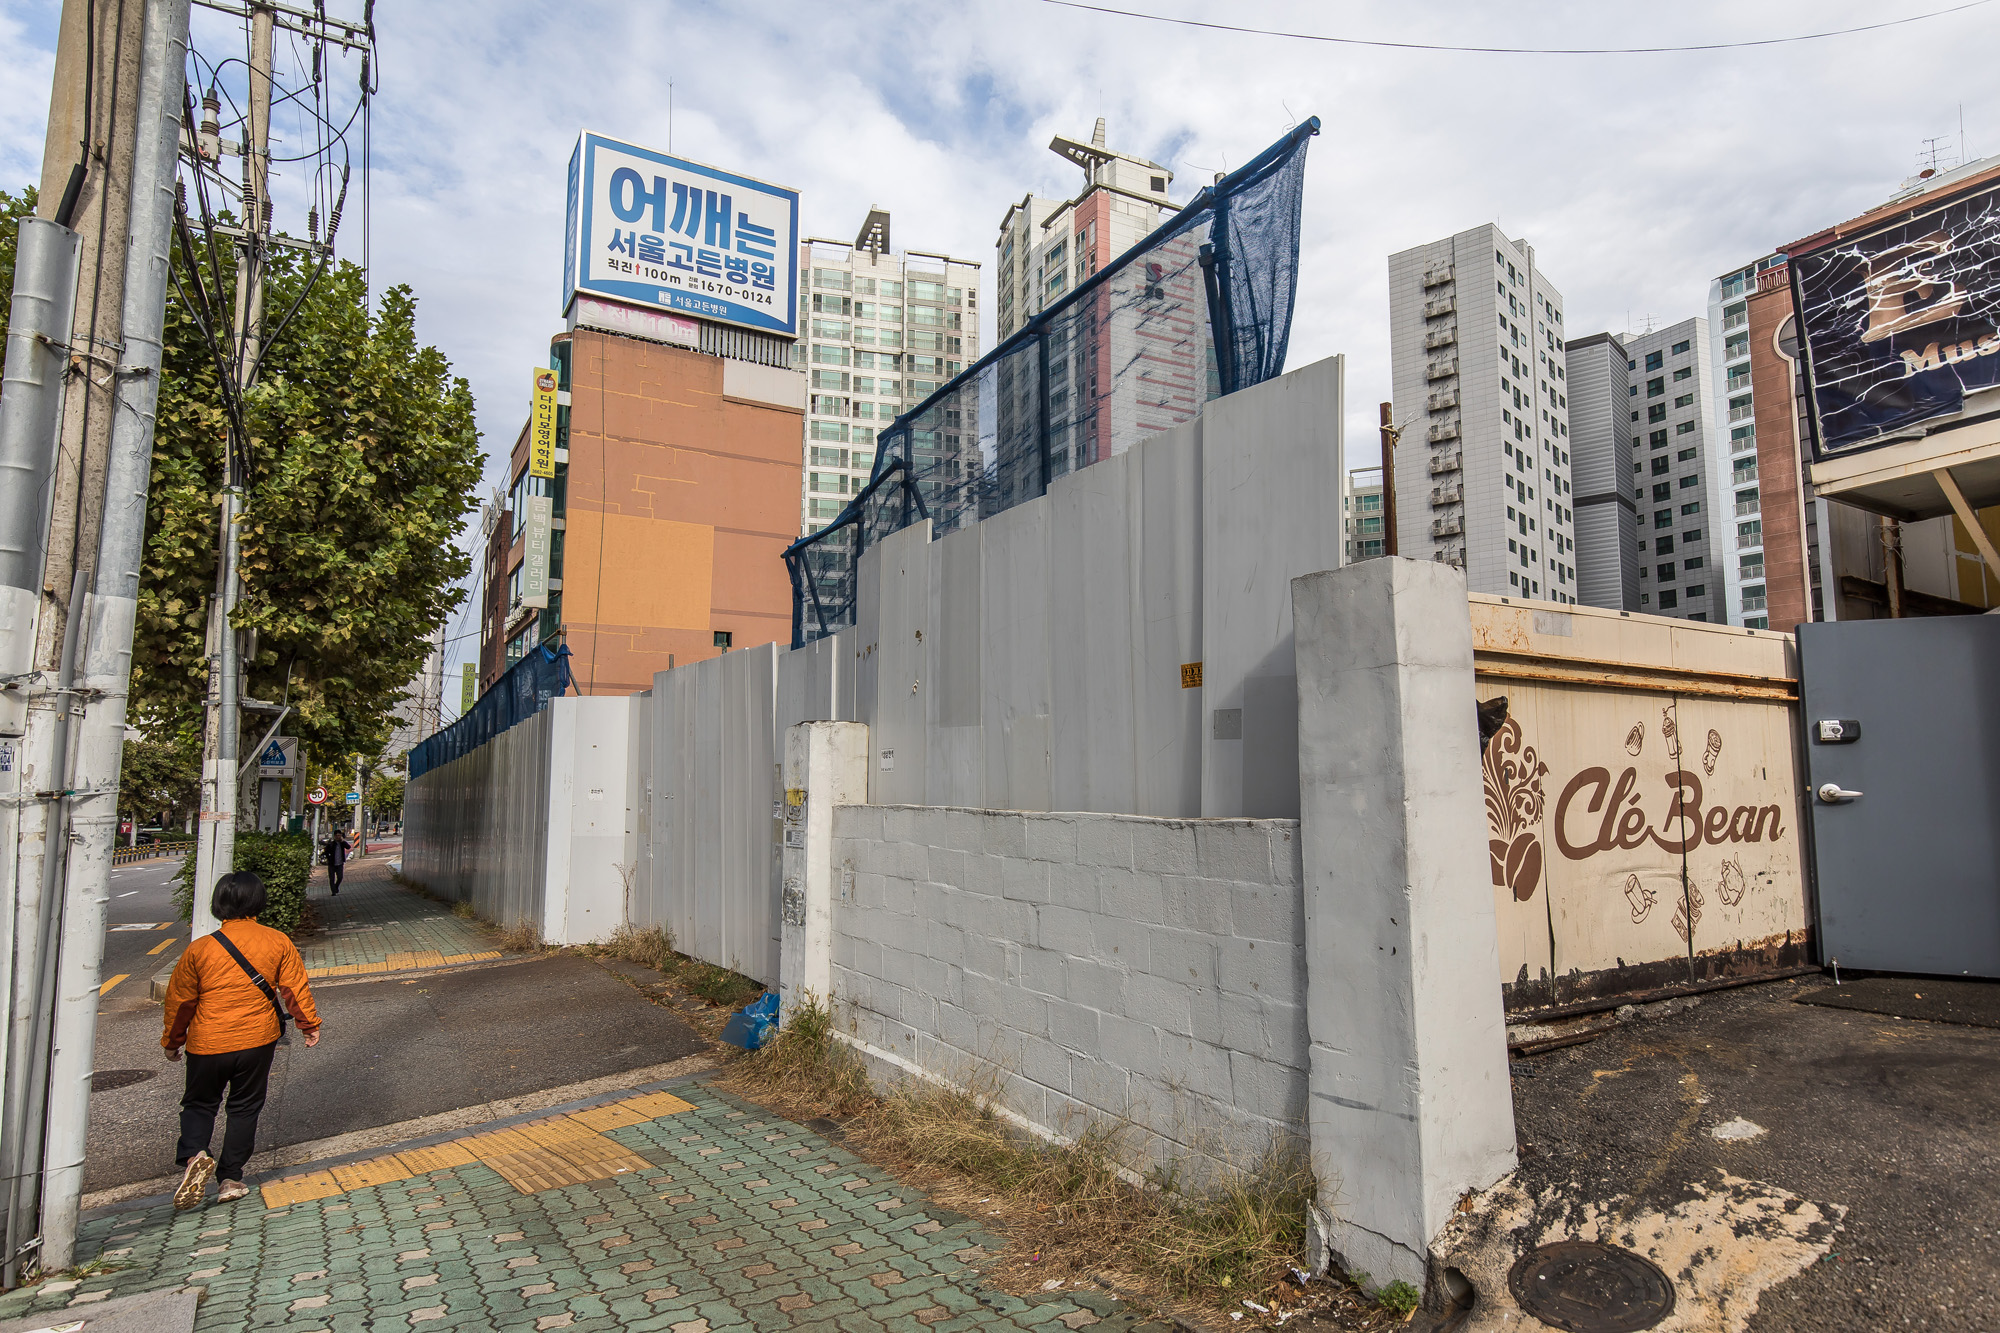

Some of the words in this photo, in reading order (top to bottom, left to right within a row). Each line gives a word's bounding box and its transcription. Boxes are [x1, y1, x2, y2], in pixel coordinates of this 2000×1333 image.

[609, 166, 776, 260] 어깨는
[607, 227, 775, 291] 서울고든병원
[608, 258, 632, 274] 직진
[644, 266, 681, 285] 100m
[700, 280, 773, 306] 1670-0124
[675, 296, 727, 316] 서울고든병원
[536, 394, 553, 470] 다이나모영어학원
